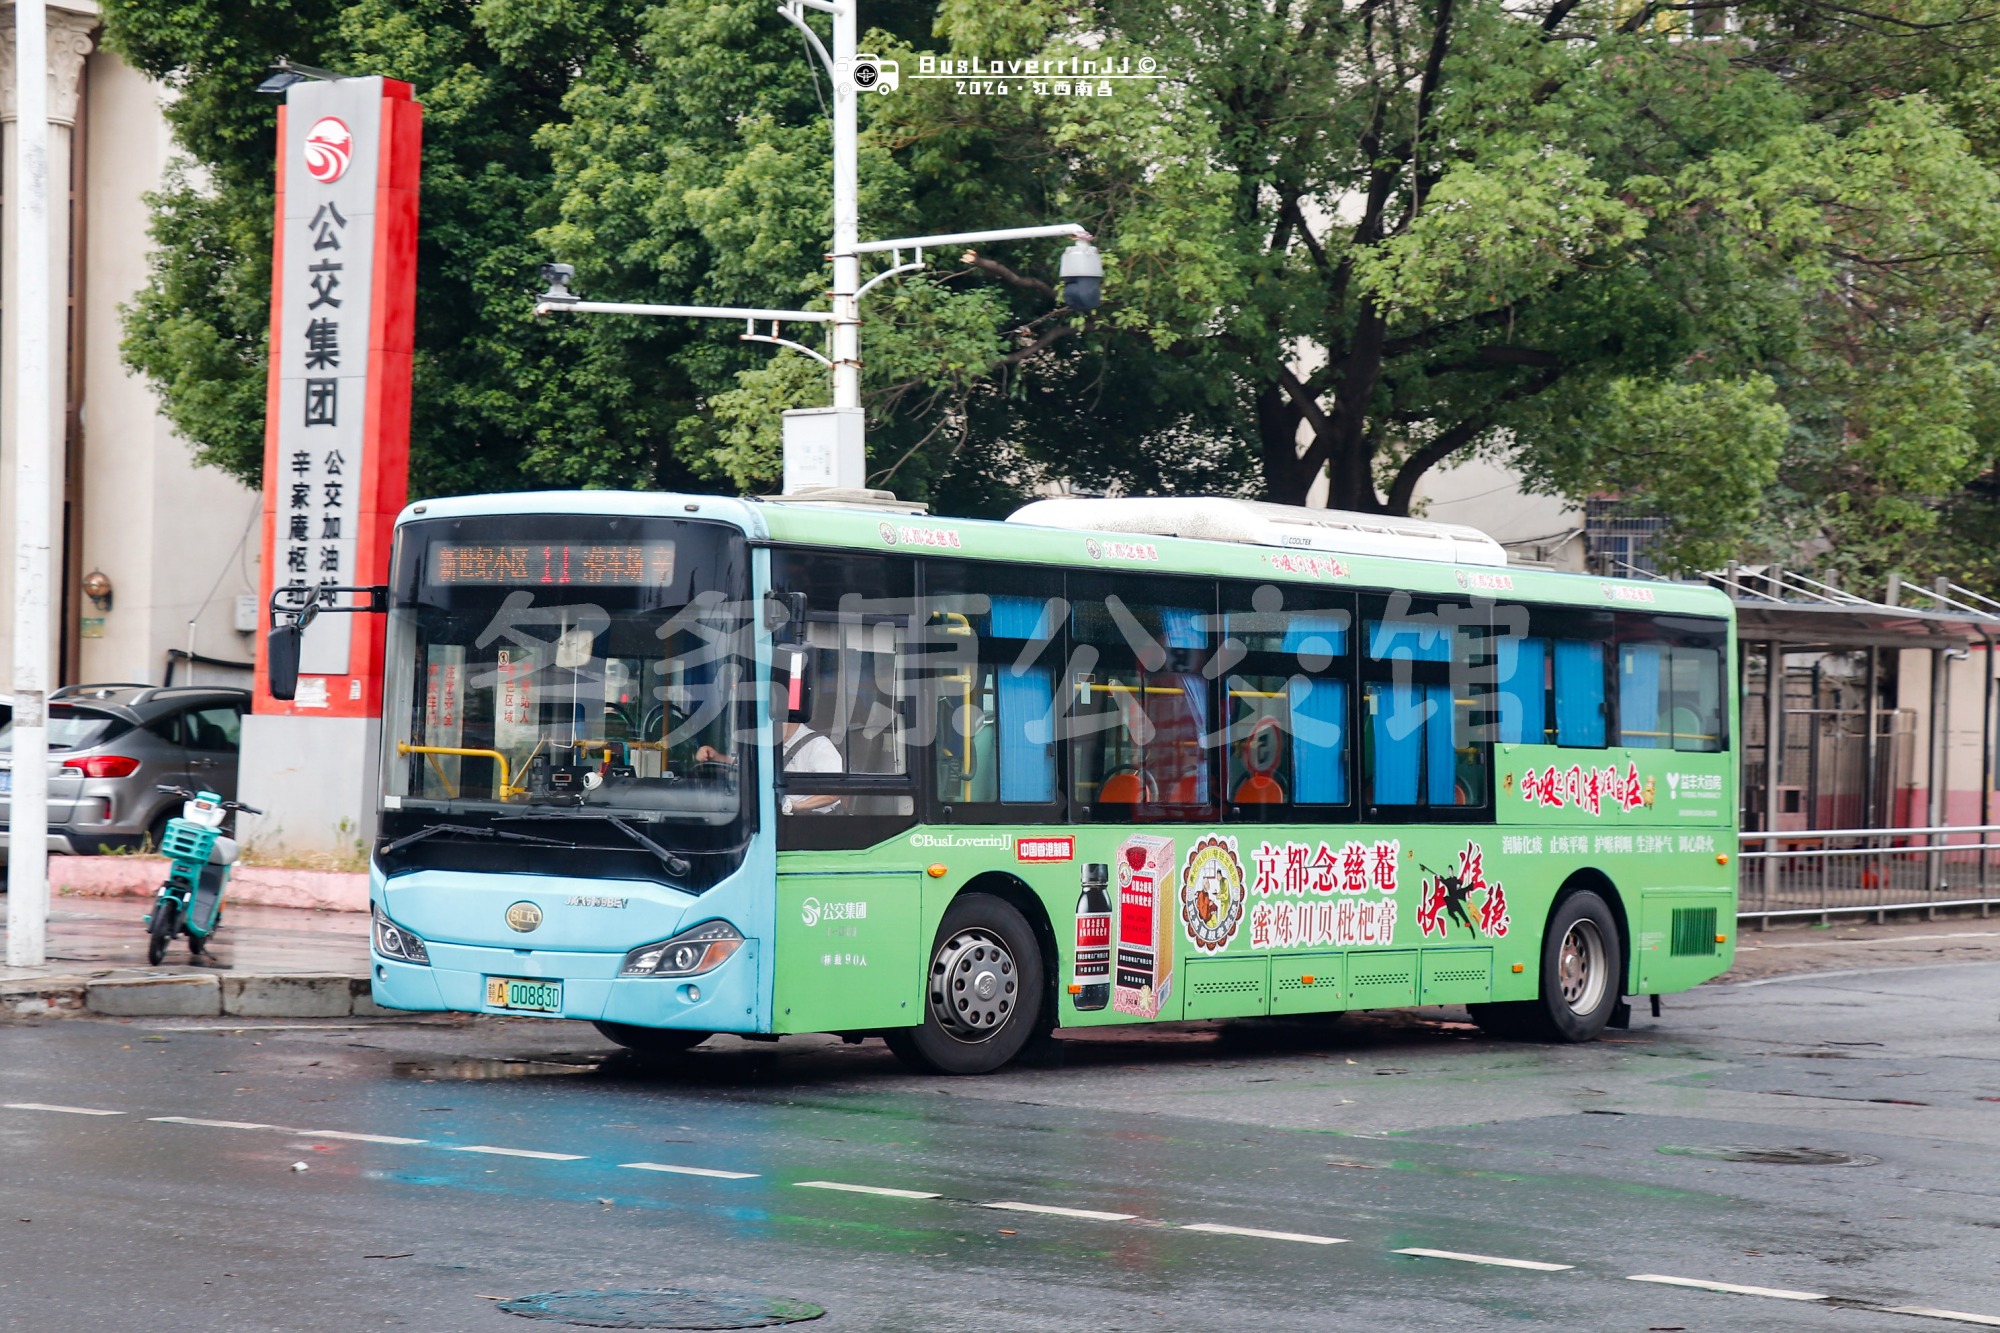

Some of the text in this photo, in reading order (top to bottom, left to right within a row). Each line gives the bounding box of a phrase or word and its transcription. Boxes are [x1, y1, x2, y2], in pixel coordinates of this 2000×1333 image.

[304, 200, 348, 428] 公交集团
[319, 449, 345, 607] 公交加油站
[540, 546, 571, 583] 11
[1680, 774, 1722, 790] 益丰大药房
[1019, 841, 1071, 858] 中国香港制造
[1254, 845, 1398, 894] 京都念慈菴
[823, 901, 867, 920] 公交集团
[1253, 901, 1395, 946] 蜜炼川贝枇杷膏
[511, 984, 560, 1008] 00883D
